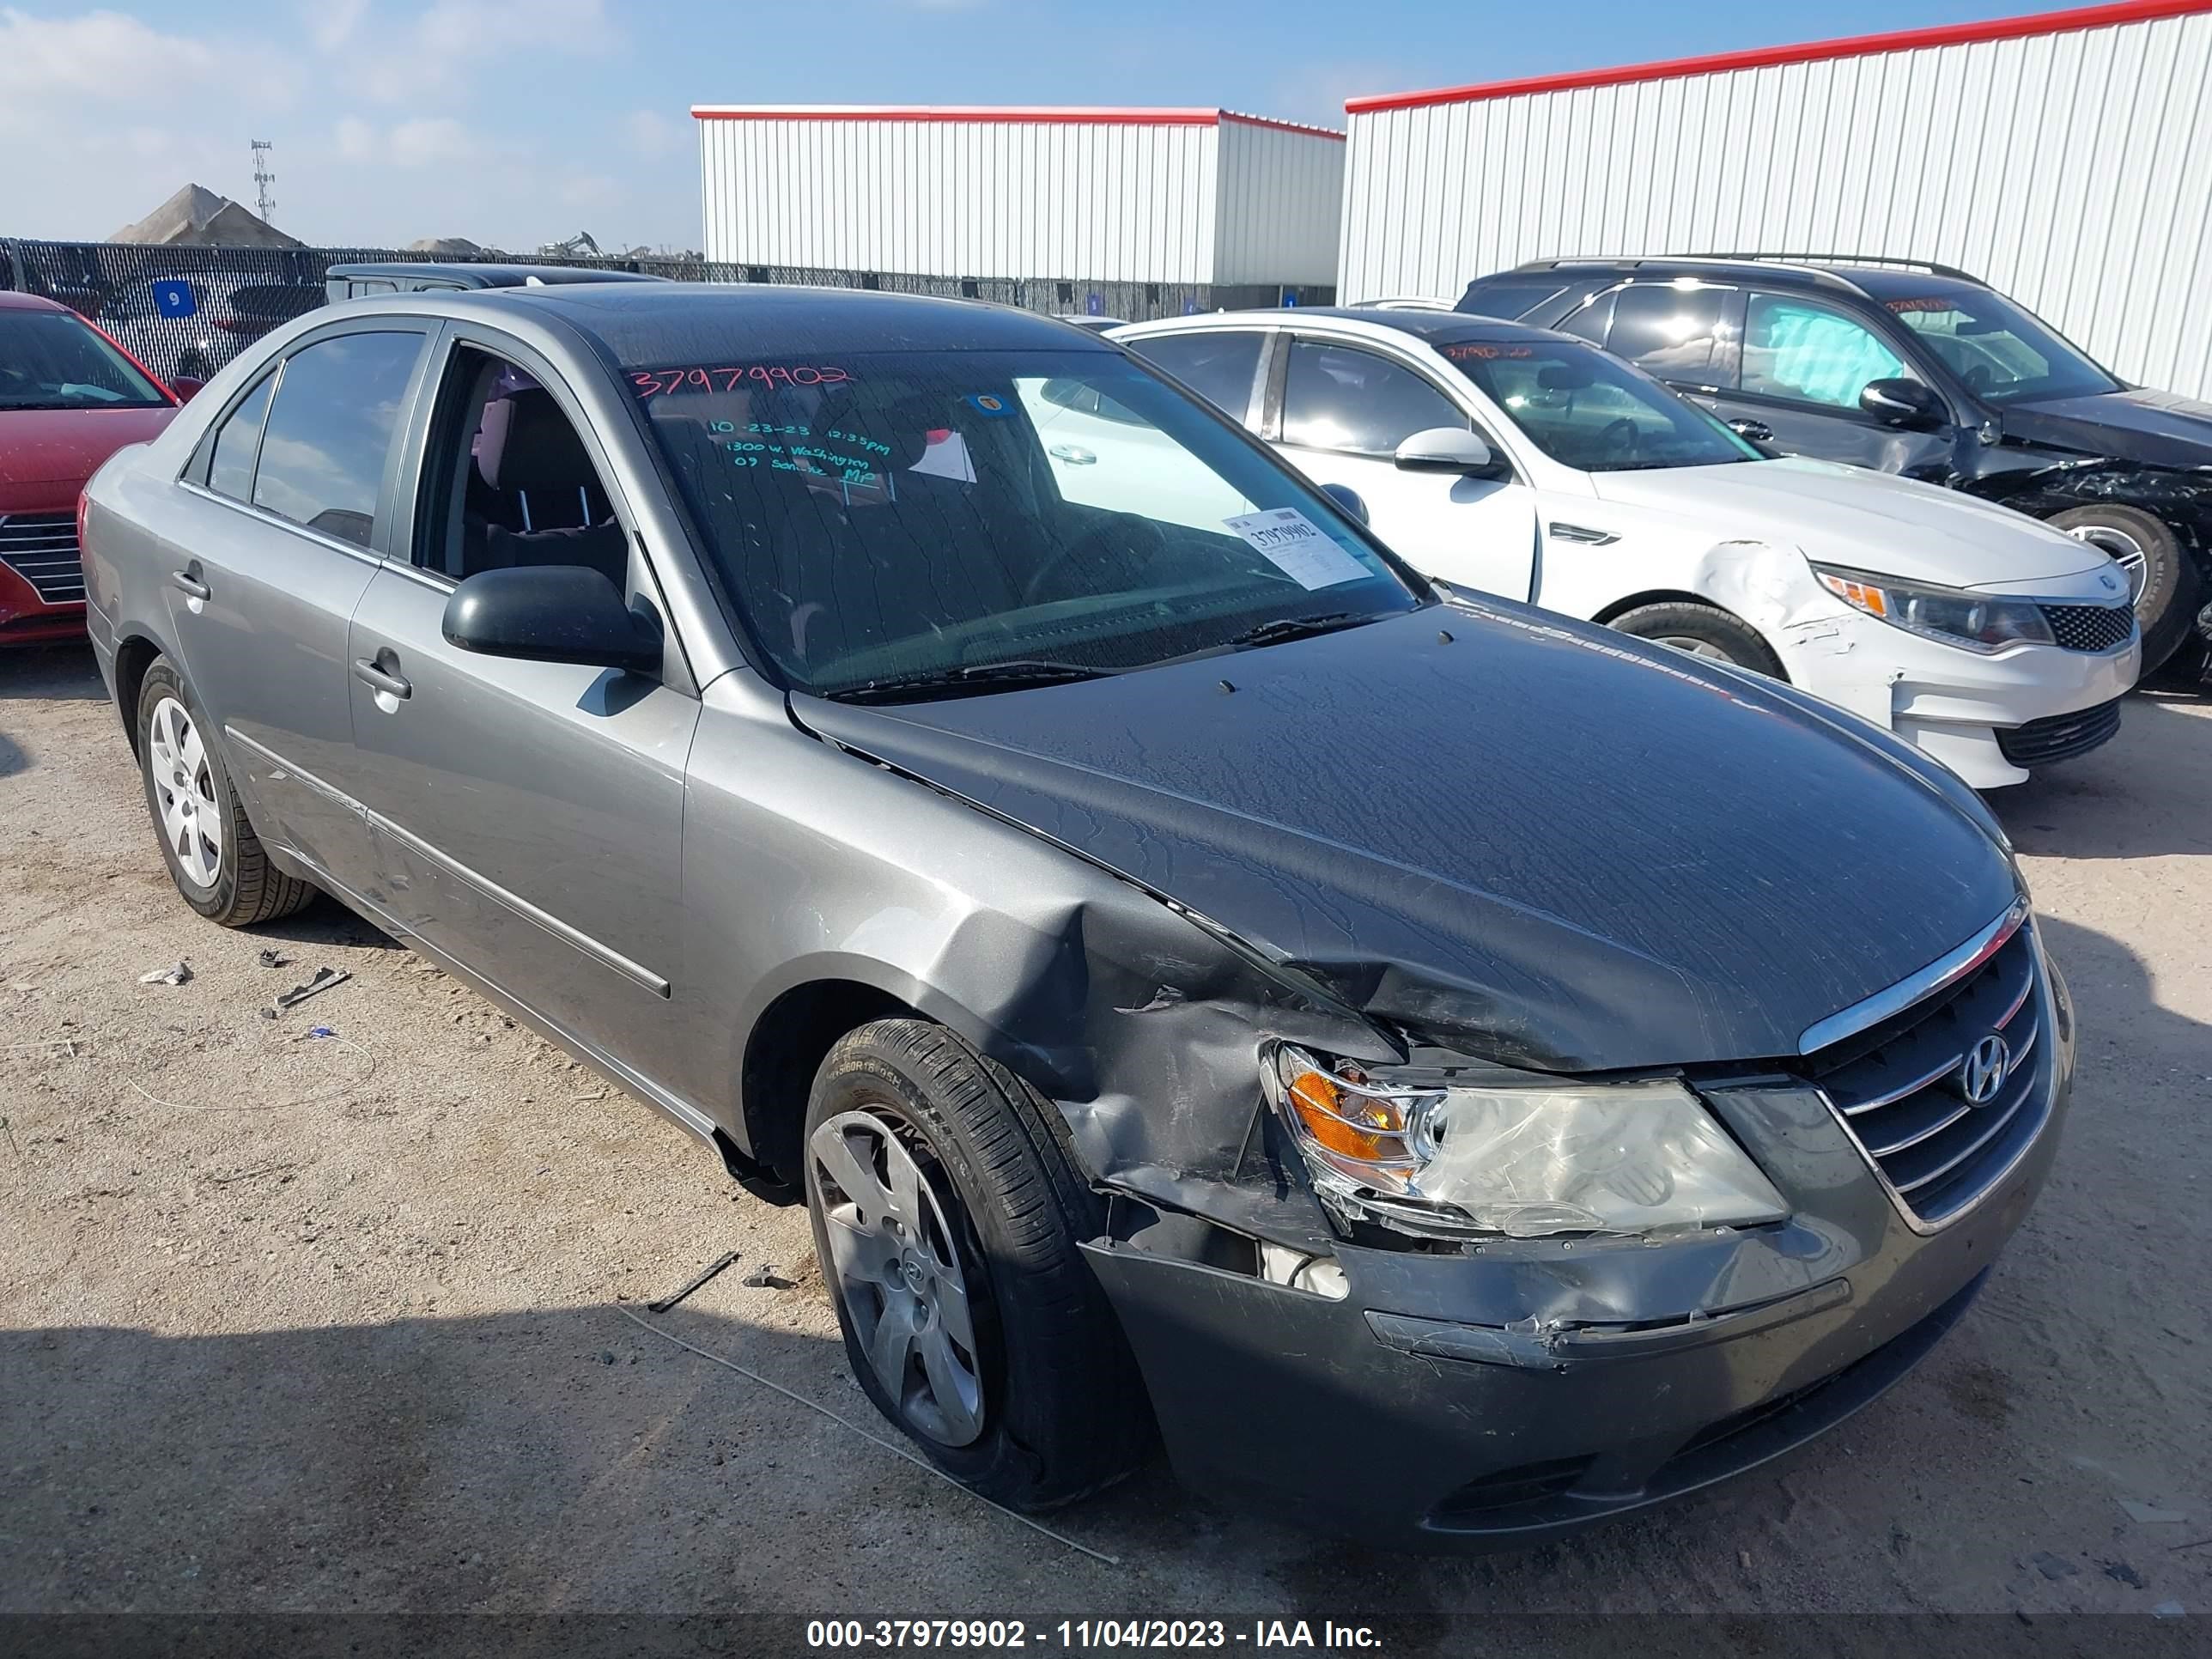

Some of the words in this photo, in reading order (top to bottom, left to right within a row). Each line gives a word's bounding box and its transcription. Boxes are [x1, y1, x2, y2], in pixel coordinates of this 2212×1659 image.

[168, 292, 179, 307] 9
[629, 366, 859, 399] 37979902
[734, 457, 758, 467] 09
[1250, 523, 1317, 547] 37979902
